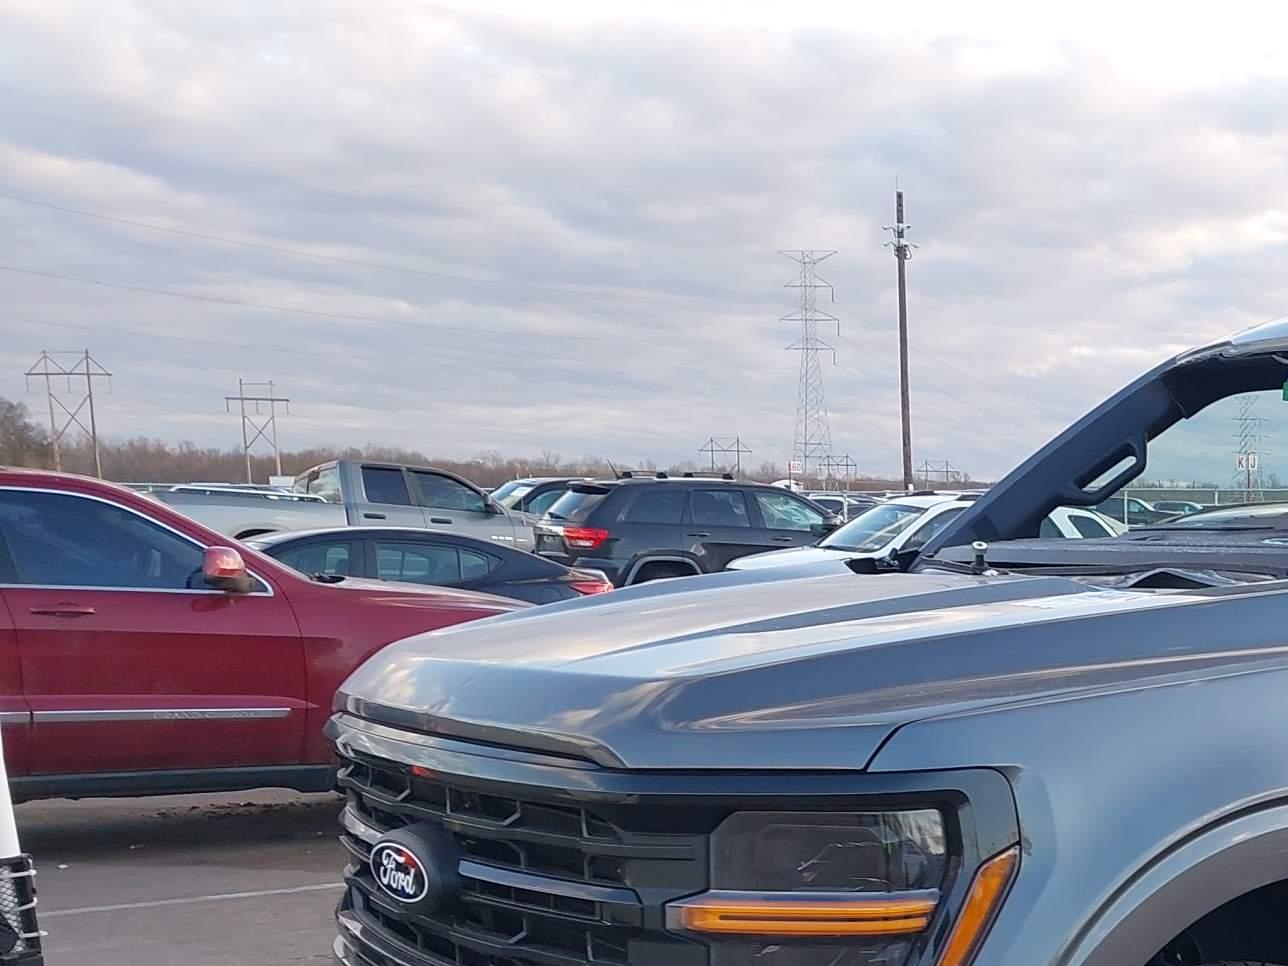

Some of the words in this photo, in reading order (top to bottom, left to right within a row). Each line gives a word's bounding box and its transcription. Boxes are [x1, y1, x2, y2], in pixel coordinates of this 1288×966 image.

[1238, 456, 1245, 468] K
[1250, 456, 1256, 468] J
[380, 849, 416, 895] Ford
